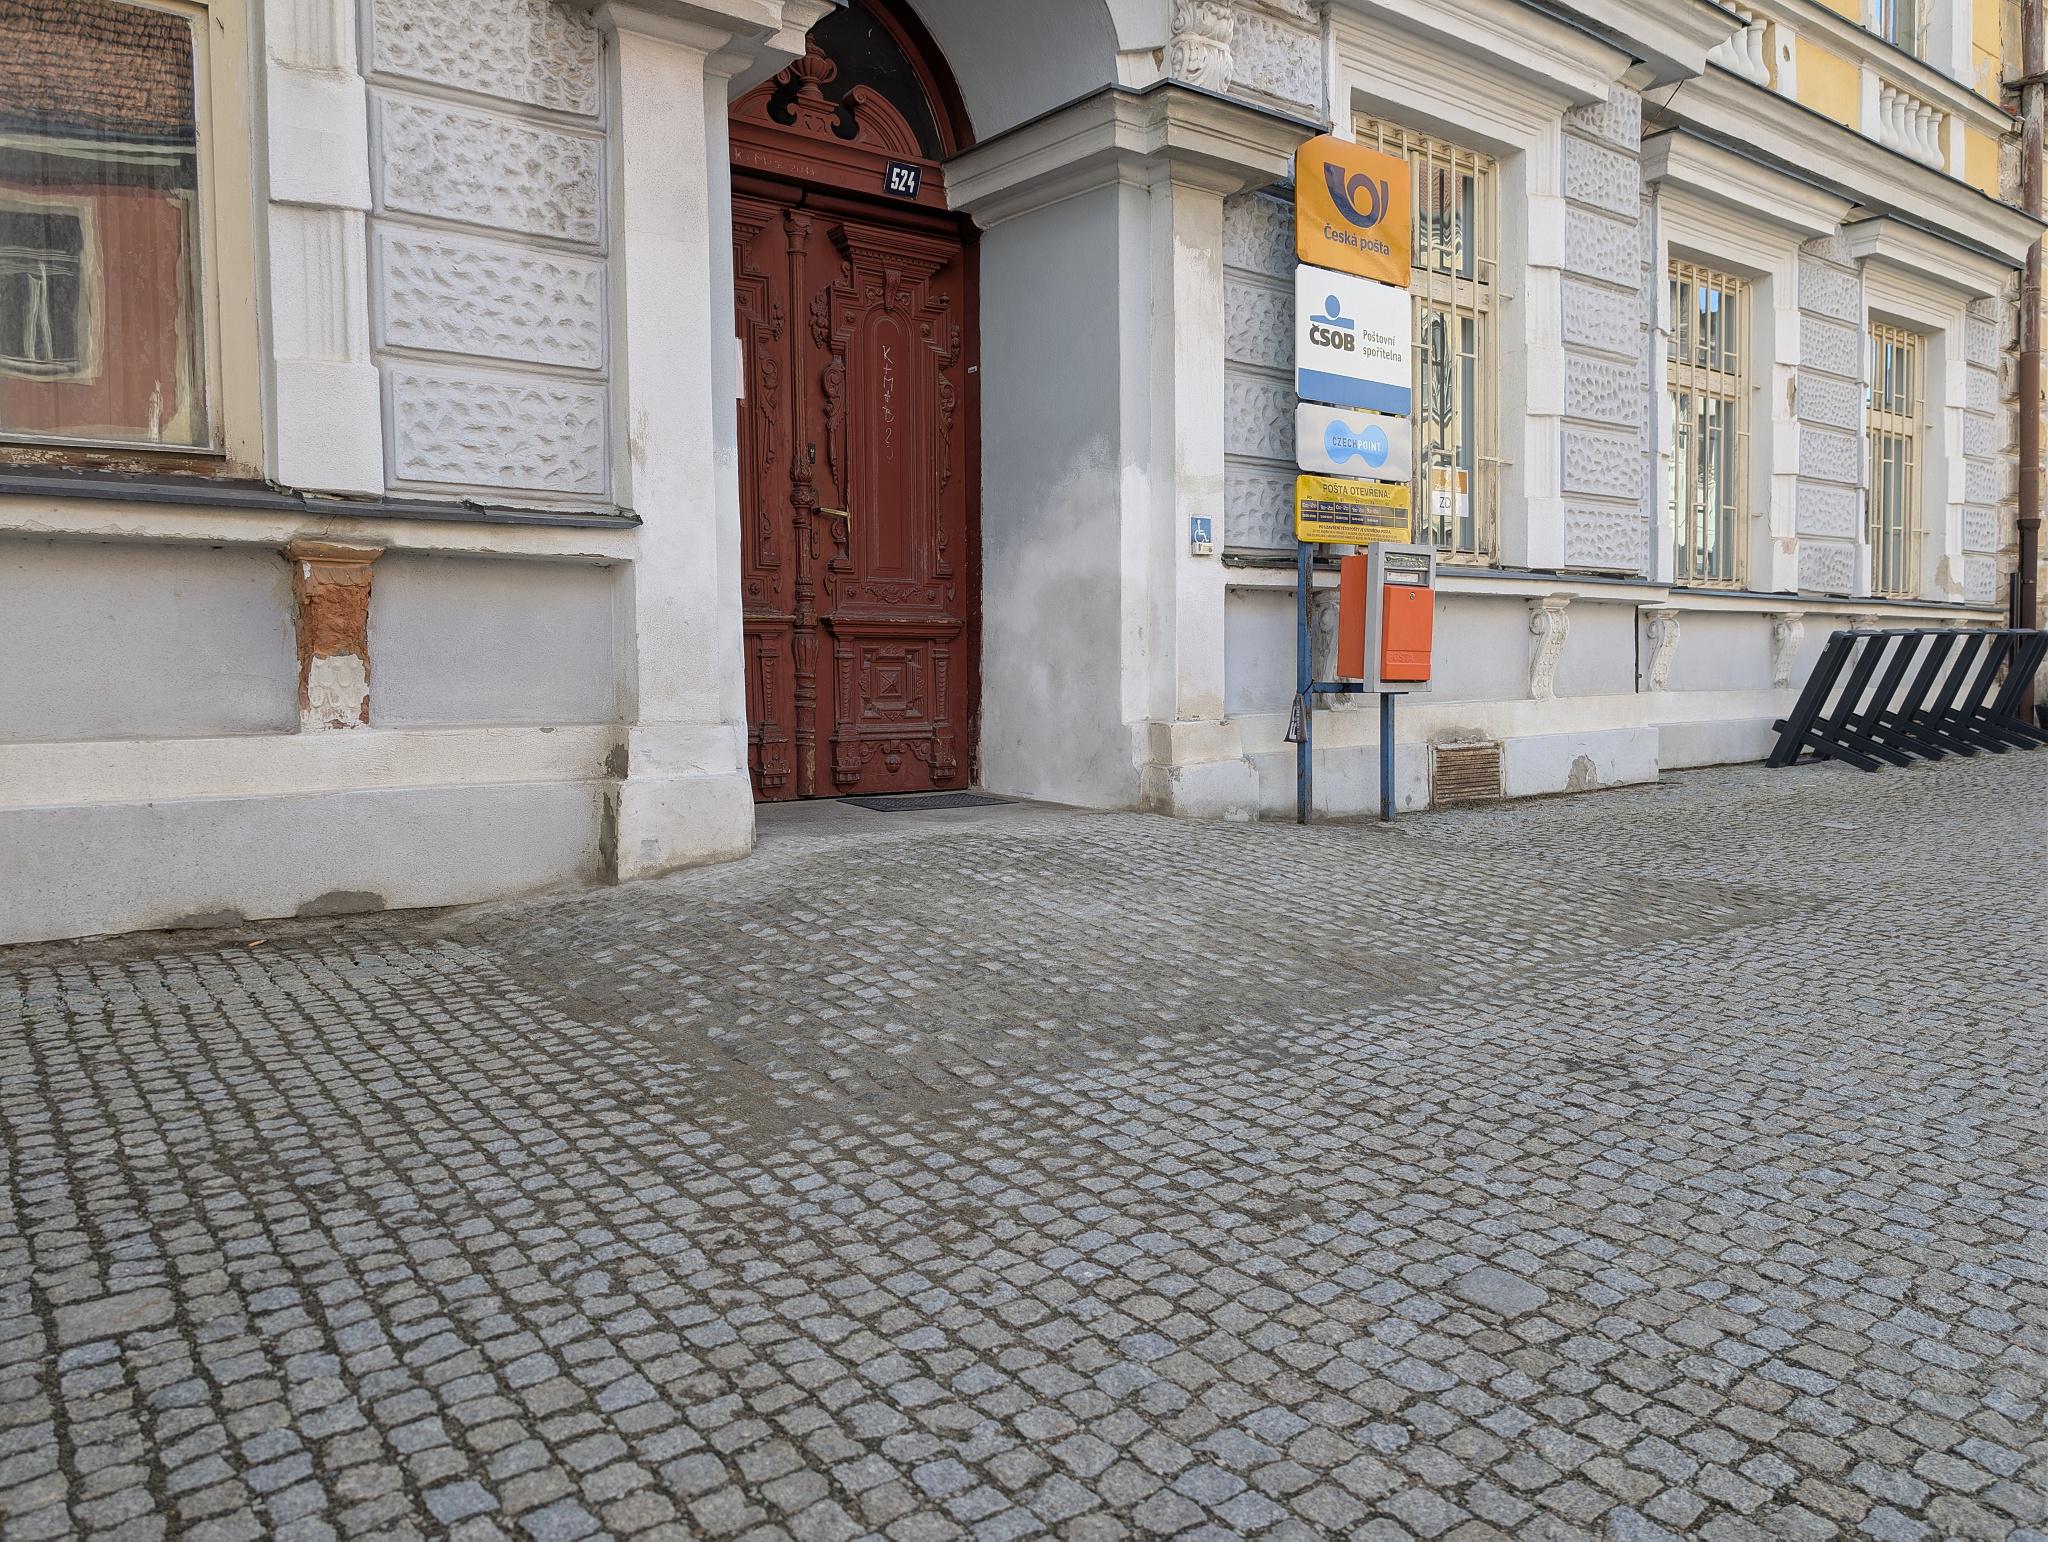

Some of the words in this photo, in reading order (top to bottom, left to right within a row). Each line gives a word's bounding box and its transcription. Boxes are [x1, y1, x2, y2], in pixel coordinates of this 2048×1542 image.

[890, 167, 915, 194] 524
[1323, 223, 1358, 247] Česká
[1360, 237, 1390, 256] pošta
[1310, 323, 1355, 352] ČSOB
[1363, 330, 1395, 346] Poštovní
[1363, 346, 1402, 362] spořitelna
[1323, 483, 1348, 495] POŠTA
[1350, 486, 1390, 499] OTEVŘENA:
